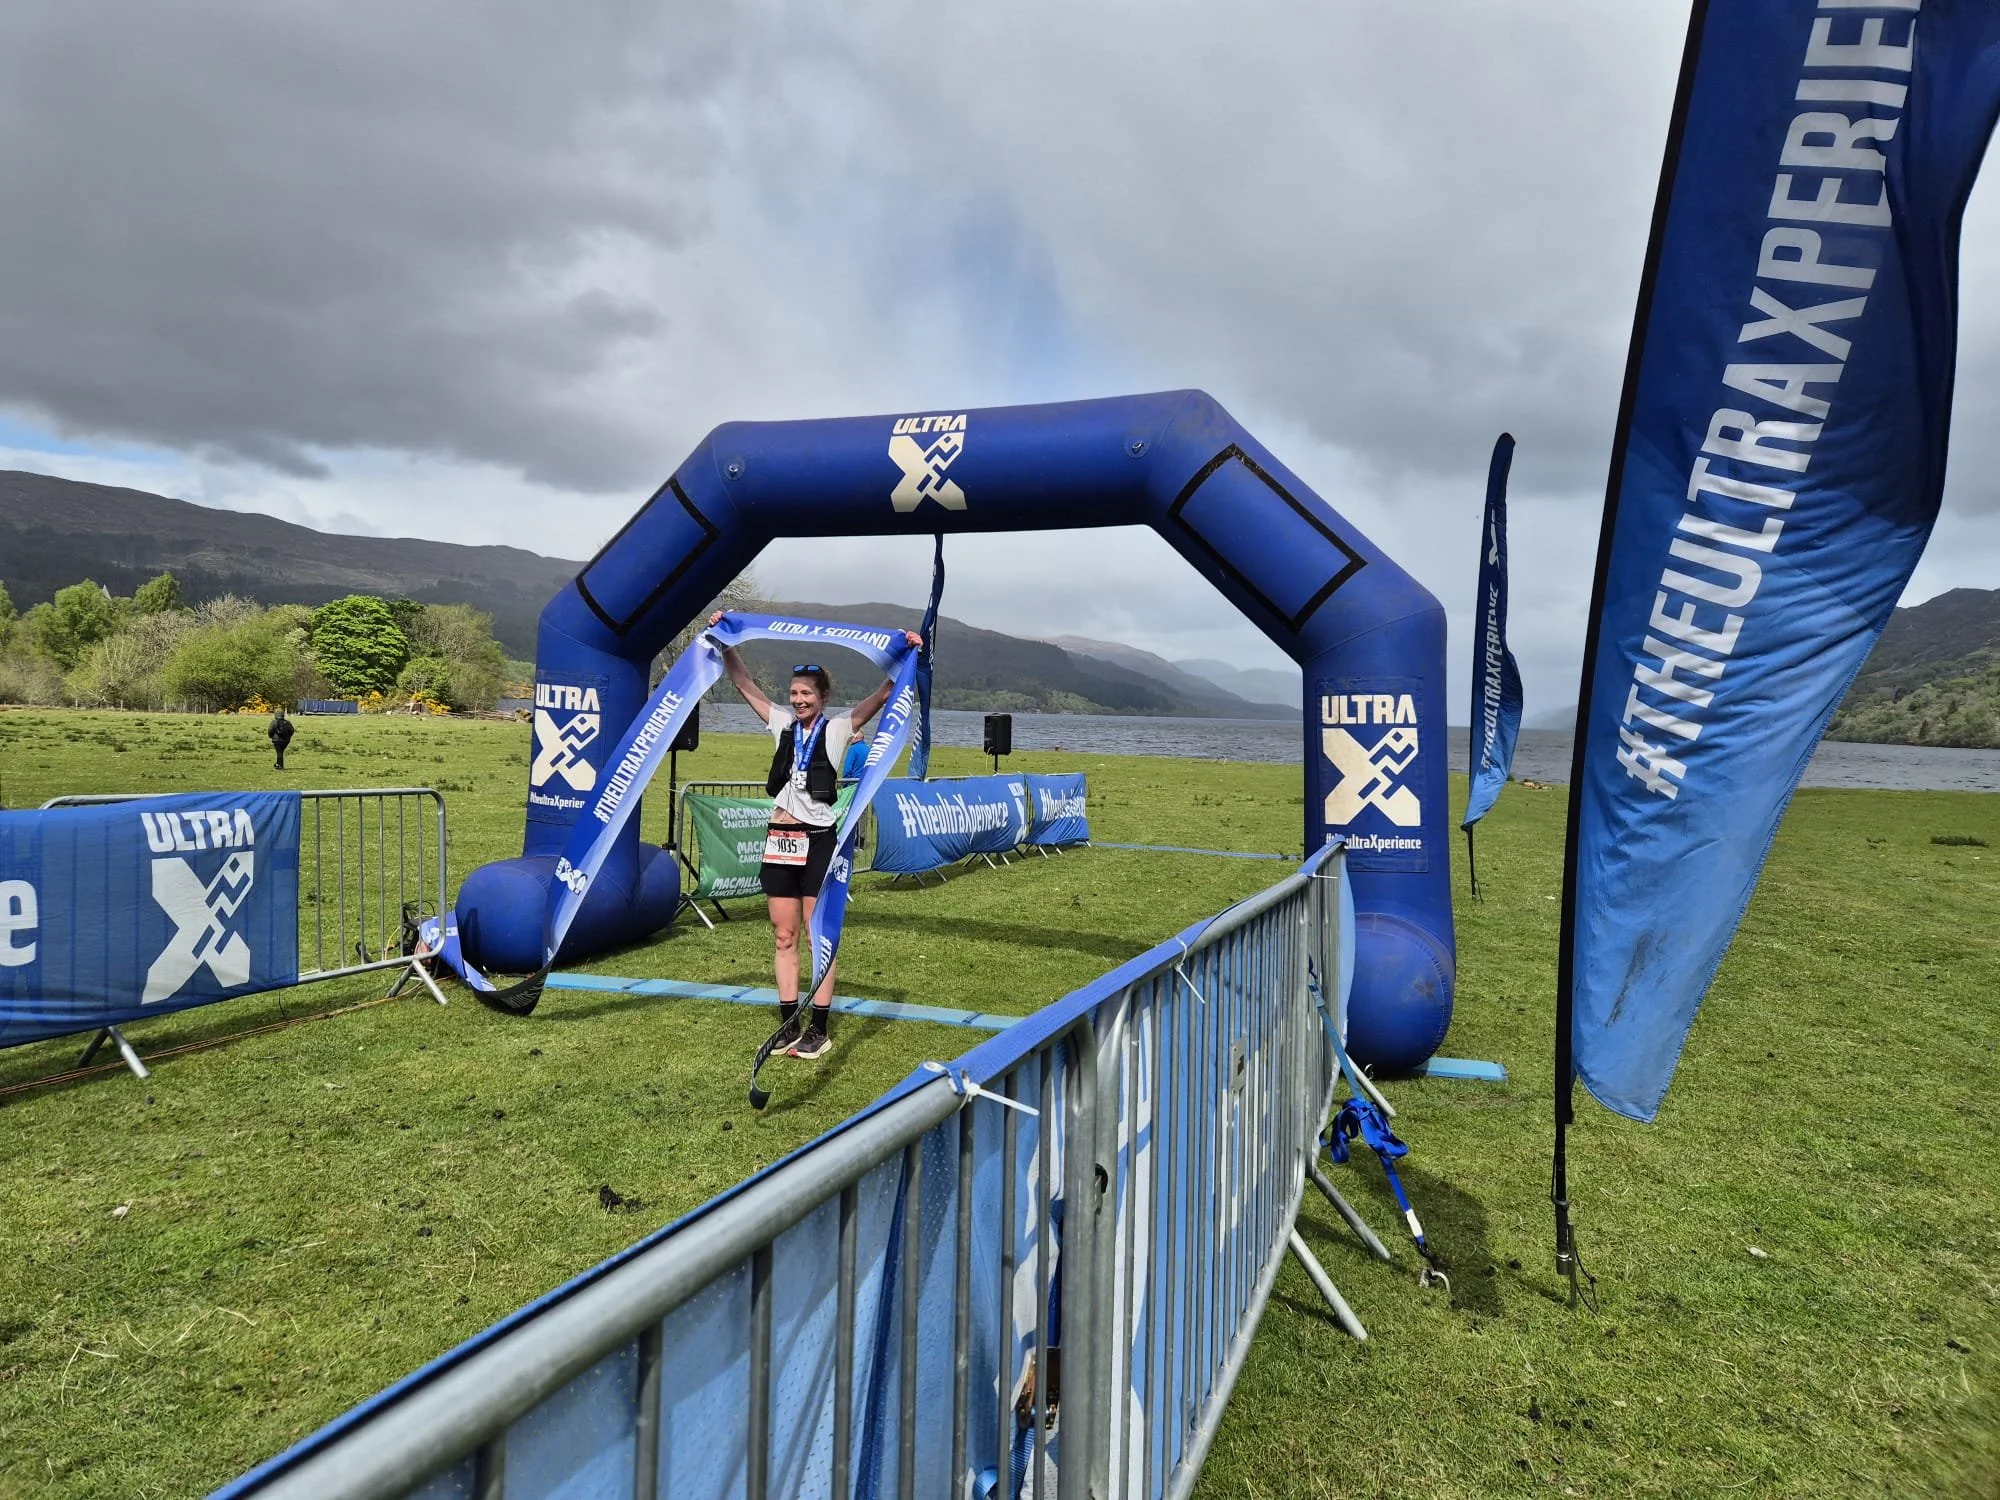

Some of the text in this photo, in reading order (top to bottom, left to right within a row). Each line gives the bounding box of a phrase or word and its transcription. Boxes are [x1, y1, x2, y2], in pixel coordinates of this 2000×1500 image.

[1615, 0, 1922, 801] #THEULTRAXPERIE
[893, 414, 967, 434] ULTRA
[767, 620, 892, 650] ULTRA X SCOTLAND
[535, 683, 600, 711] ULTRA
[1321, 694, 1417, 724] ULTRA
[886, 712, 904, 726] 2
[593, 690, 684, 824] #THEULTRAXPERIENCE
[141, 809, 255, 852] ULTRA
[722, 819, 750, 829] CANCER
[896, 793, 1009, 842] #theultraXperience
[777, 838, 797, 854] 1035
[1326, 832, 1422, 852] #ultraXperience
